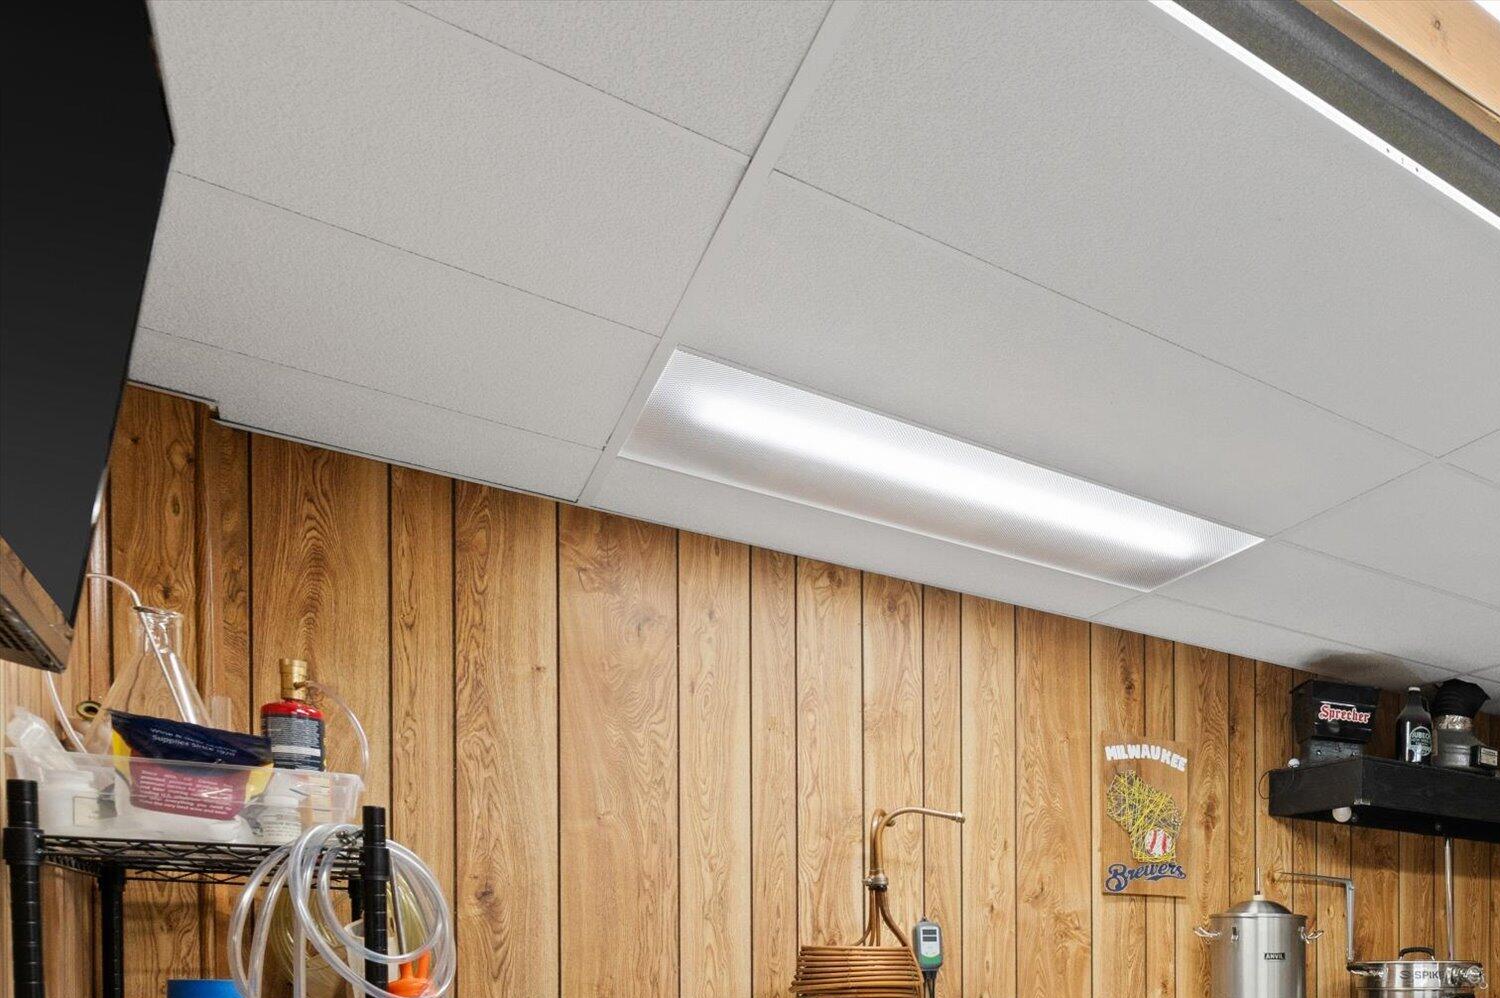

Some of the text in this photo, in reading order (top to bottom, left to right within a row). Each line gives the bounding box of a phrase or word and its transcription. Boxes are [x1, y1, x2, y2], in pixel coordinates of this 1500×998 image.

[1318, 705, 1371, 723] Sprecher
[1105, 743, 1188, 772] MILWAUKEE
[1105, 862, 1187, 893] Brewers
[1414, 970, 1439, 980] SPIK
